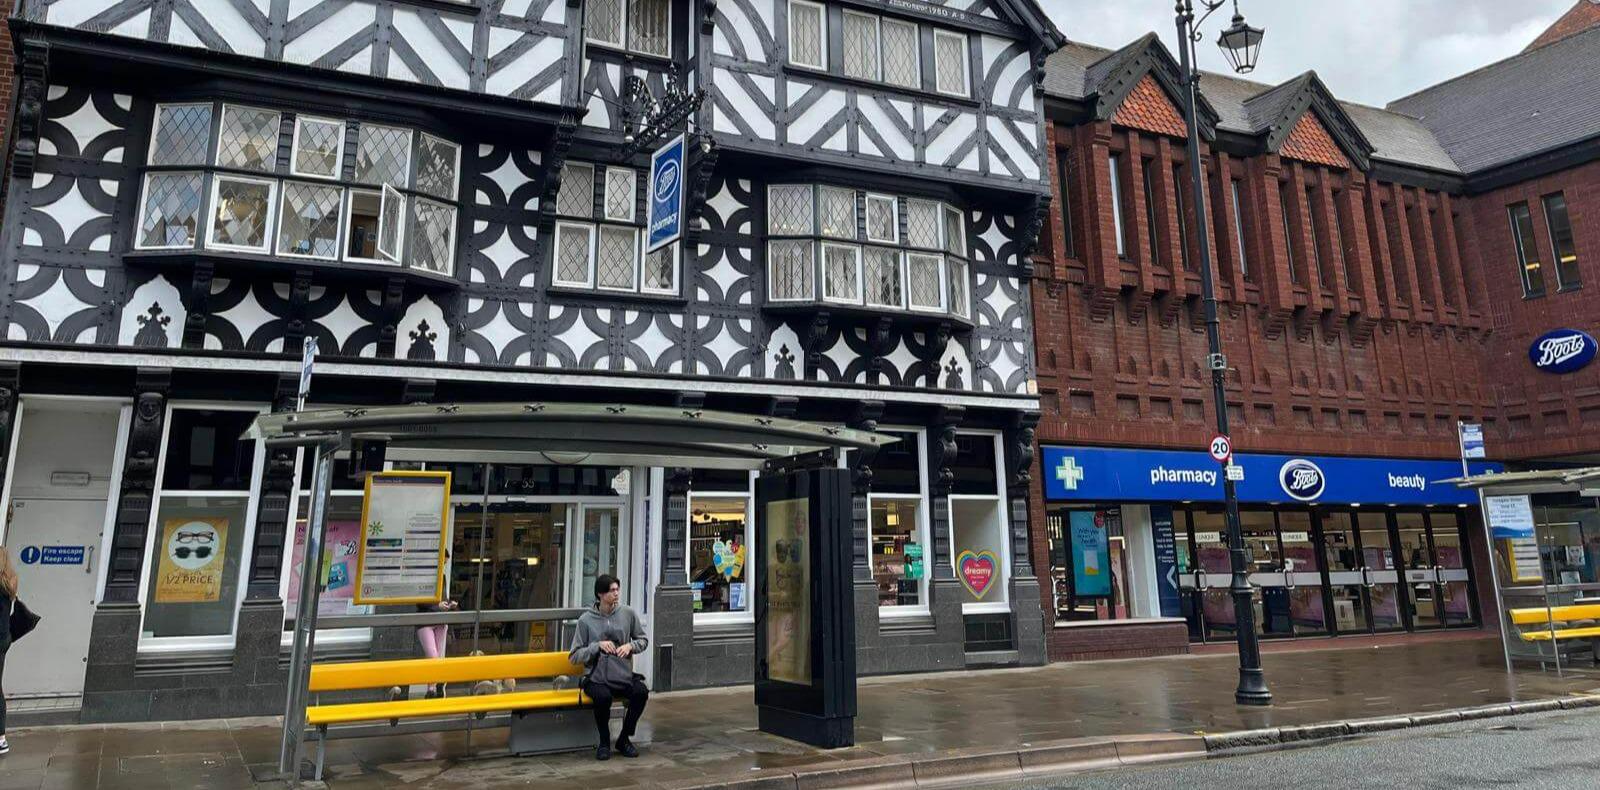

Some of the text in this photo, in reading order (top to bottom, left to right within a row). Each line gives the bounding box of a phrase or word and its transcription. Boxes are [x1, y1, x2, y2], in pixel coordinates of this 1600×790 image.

[928, 6, 948, 16] 1980
[657, 165, 676, 197] Boots
[651, 211, 678, 235] pharmacy
[1536, 334, 1585, 367] Boots
[1212, 442, 1228, 454] 20
[1150, 465, 1217, 487] pharmacy
[1289, 468, 1319, 490] Boots
[1388, 472, 1426, 491] beauty
[166, 575, 213, 585] 1/2 PRICE
[964, 566, 992, 577] dreamy
